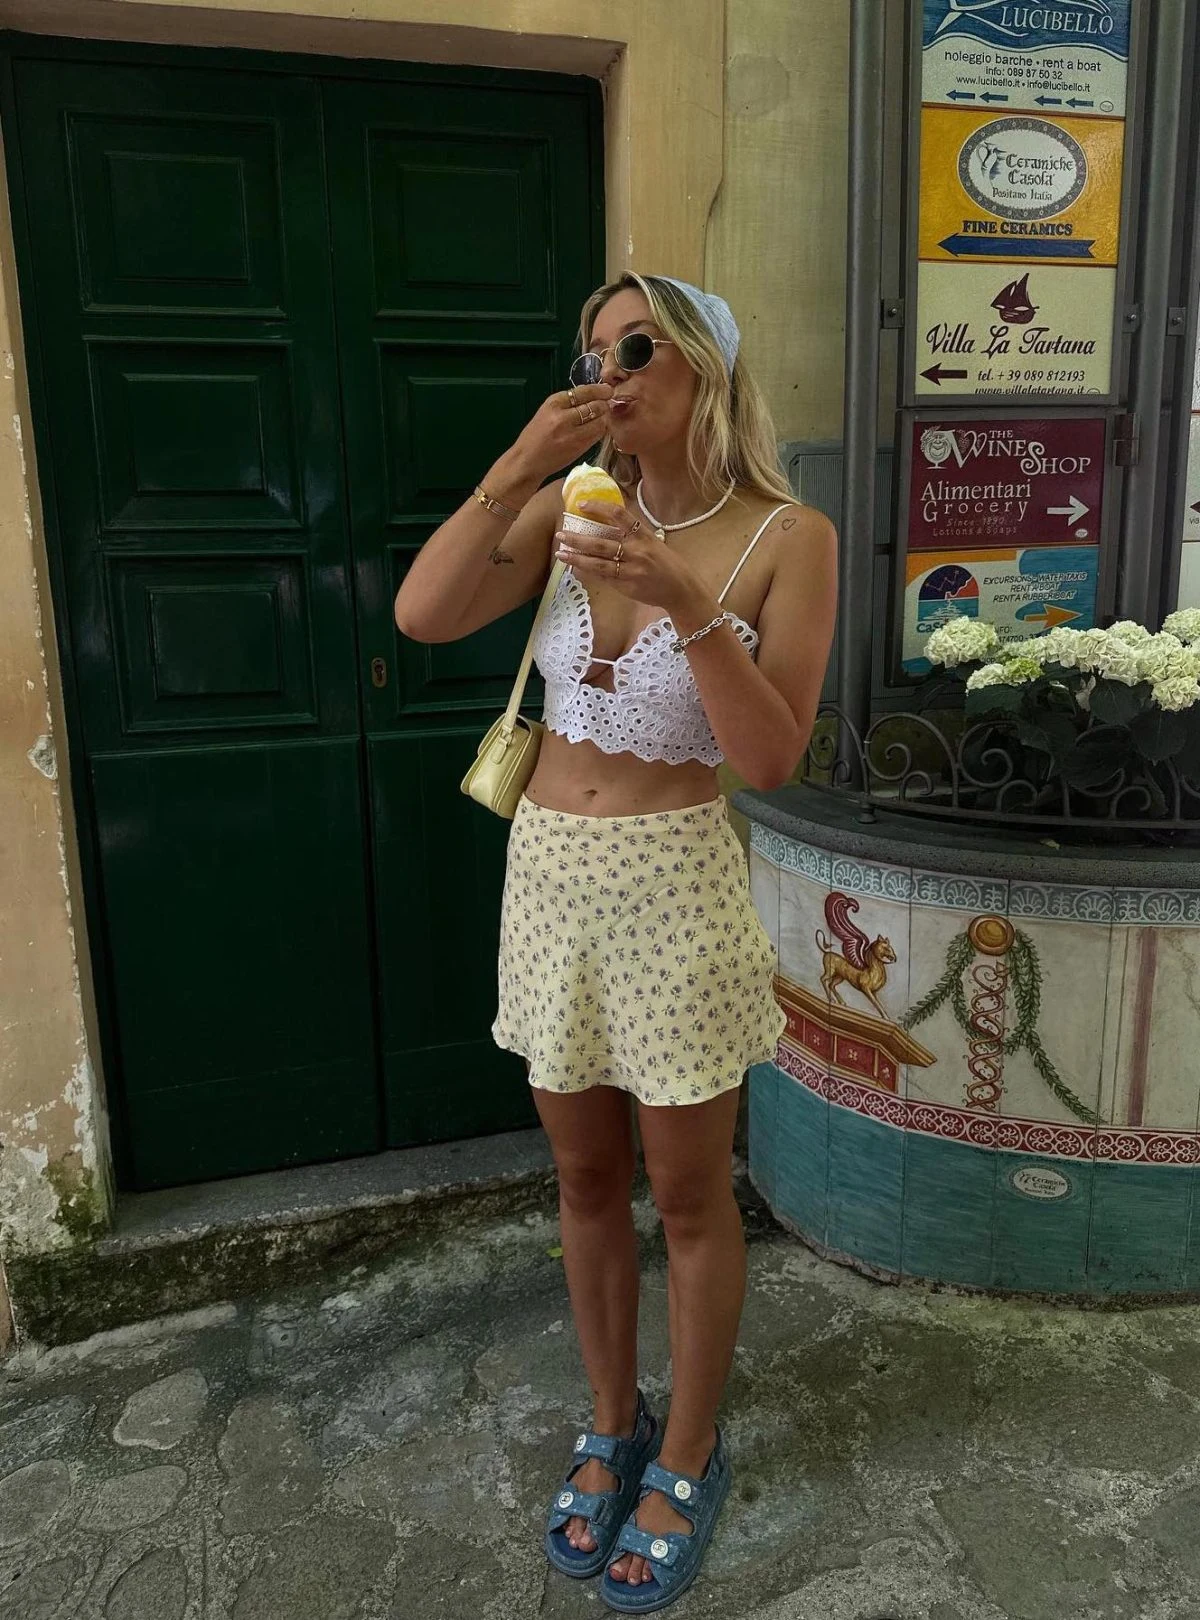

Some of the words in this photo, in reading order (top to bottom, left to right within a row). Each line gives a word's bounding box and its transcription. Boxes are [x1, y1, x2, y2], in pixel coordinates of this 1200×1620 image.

[1001, 6, 1114, 35] LUCIBELLO
[944, 51, 991, 66] noleggio
[995, 53, 1033, 67] barche
[1042, 58, 1064, 70] rent
[1067, 62, 1074, 70] a
[1077, 60, 1102, 72] boat
[985, 66, 1005, 76] info:
[1007, 67, 1023, 77] 089
[1025, 68, 1036, 78] 87
[1039, 69, 1050, 79] 50
[1052, 70, 1063, 80] 32
[956, 76, 1021, 88] www.lucibello.it
[1026, 80, 1091, 93] info@lucibello.it
[1005, 153, 1074, 172] Ceramiche
[962, 220, 998, 234] FINE
[1000, 221, 1073, 236] CERAMICS
[926, 322, 976, 355] Villa
[980, 325, 1011, 360] La
[1018, 327, 1097, 355] Tartana
[977, 368, 994, 381] tel.
[1007, 370, 1021, 381] 39
[1024, 370, 1044, 381] 089
[1046, 370, 1085, 382] 812193
[989, 429, 1013, 438] THE
[921, 478, 1032, 501] Alimentari
[923, 500, 1029, 523] Grocery
[983, 574, 1033, 585] EXCURSIONS
[1010, 584, 1030, 592] RENT
[993, 594, 1014, 603] RENT
